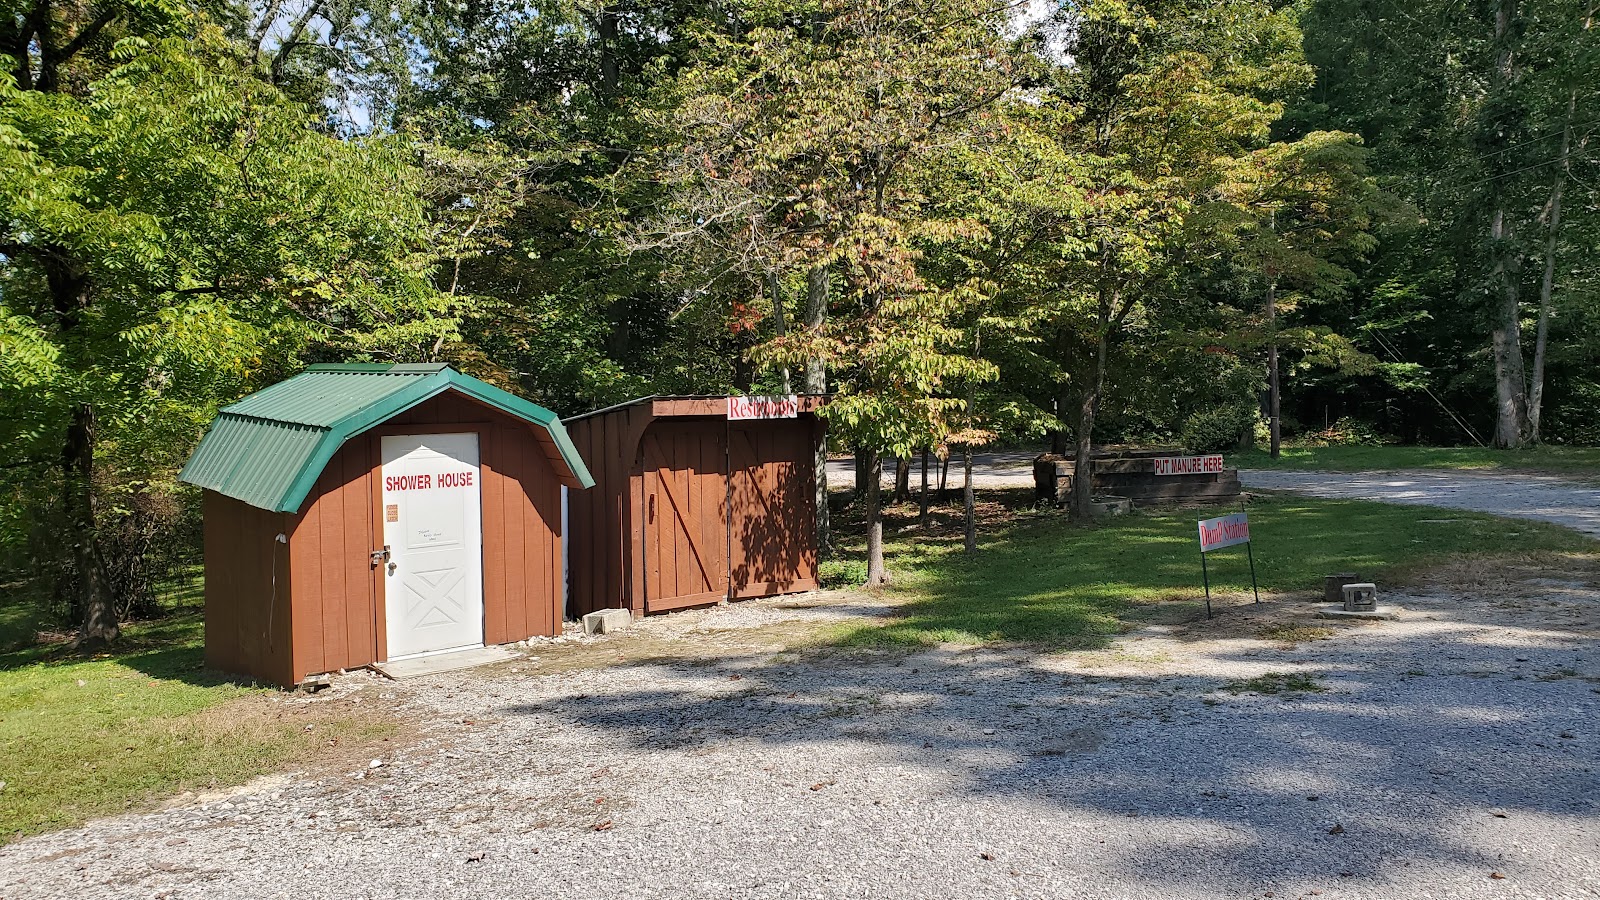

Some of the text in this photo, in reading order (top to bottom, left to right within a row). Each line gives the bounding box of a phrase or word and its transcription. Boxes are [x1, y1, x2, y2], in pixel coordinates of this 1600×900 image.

[730, 397, 795, 418] Restrooms
[1155, 456, 1223, 475] PUT MANURE HERE
[386, 471, 473, 492] SHOWER HOUSE
[1223, 517, 1249, 541] Station
